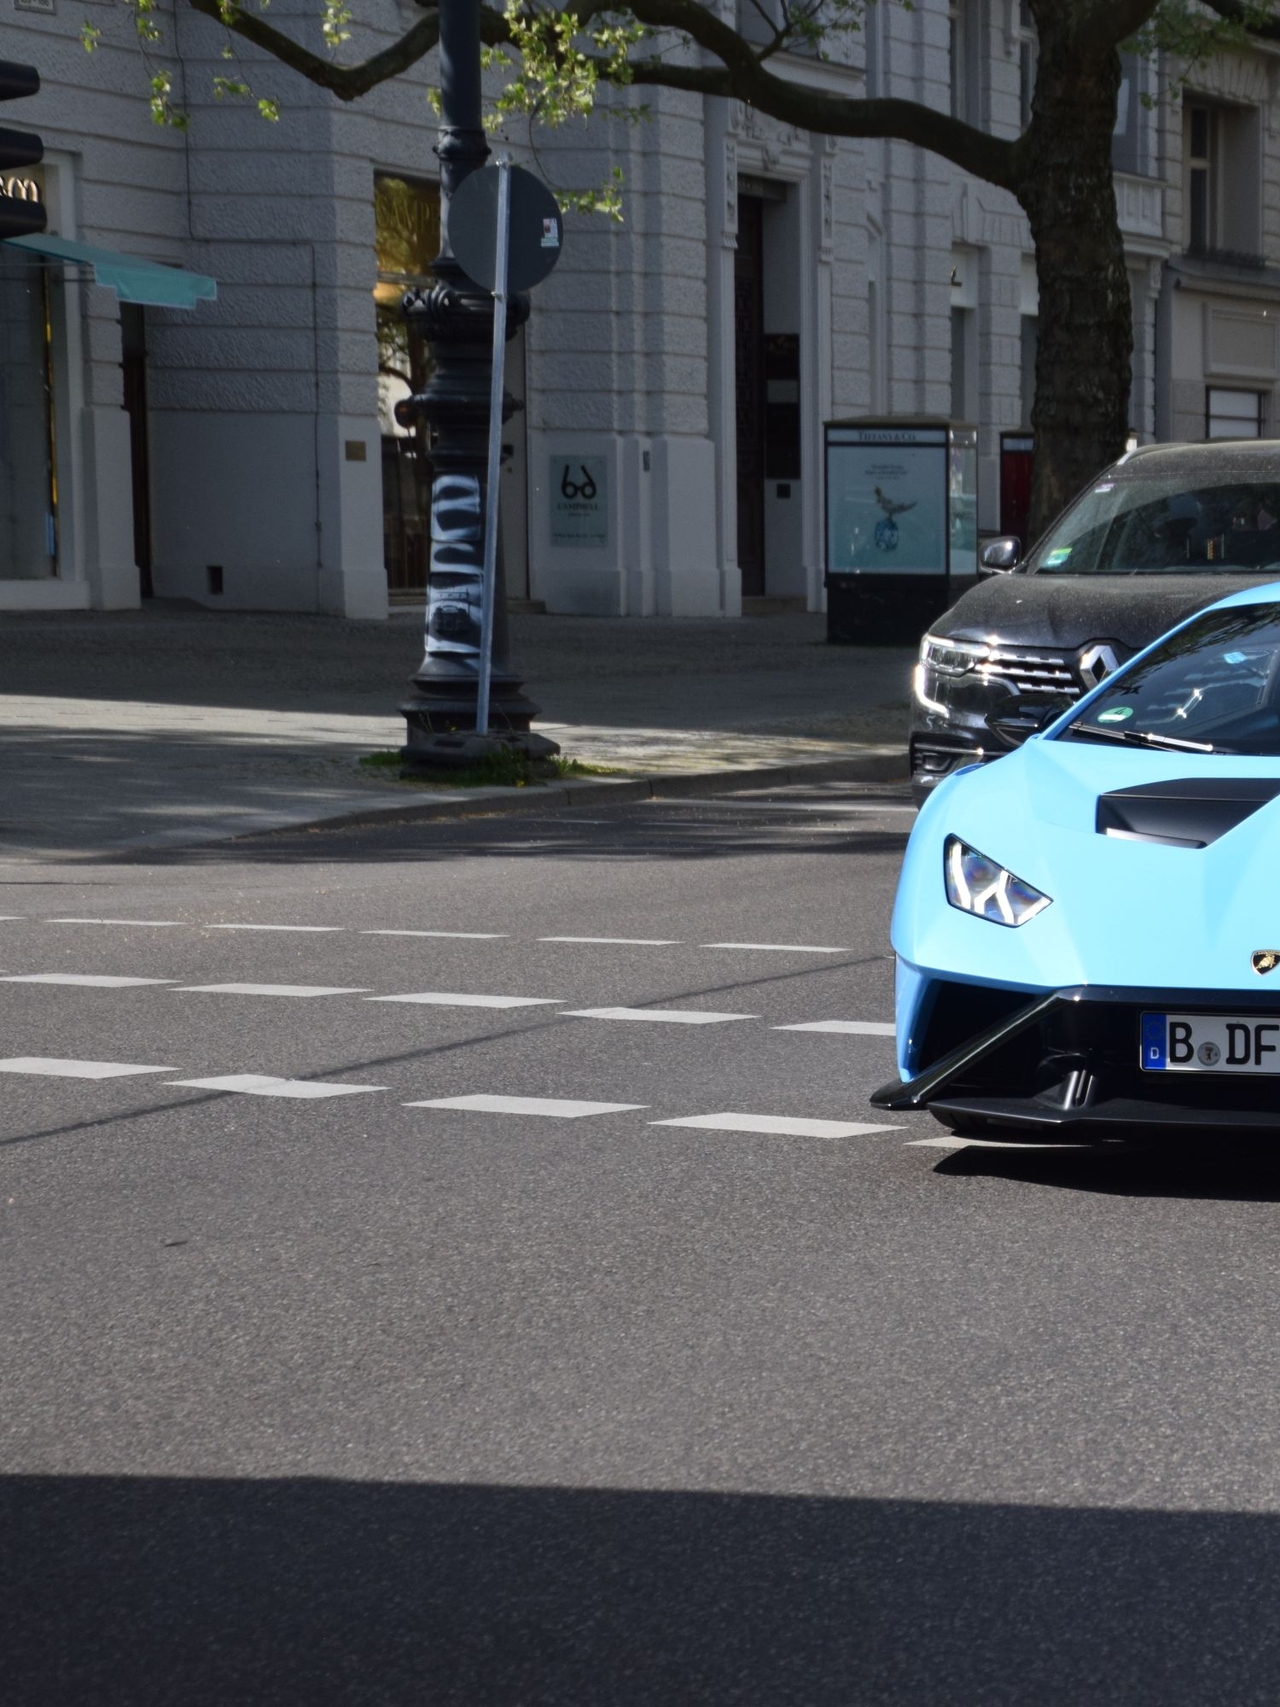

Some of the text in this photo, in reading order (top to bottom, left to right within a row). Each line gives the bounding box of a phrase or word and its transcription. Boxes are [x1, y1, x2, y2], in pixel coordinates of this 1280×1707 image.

[1150, 1047, 1160, 1059] D
[1169, 1021, 1194, 1064] B
[1225, 1023, 1280, 1066] DF
